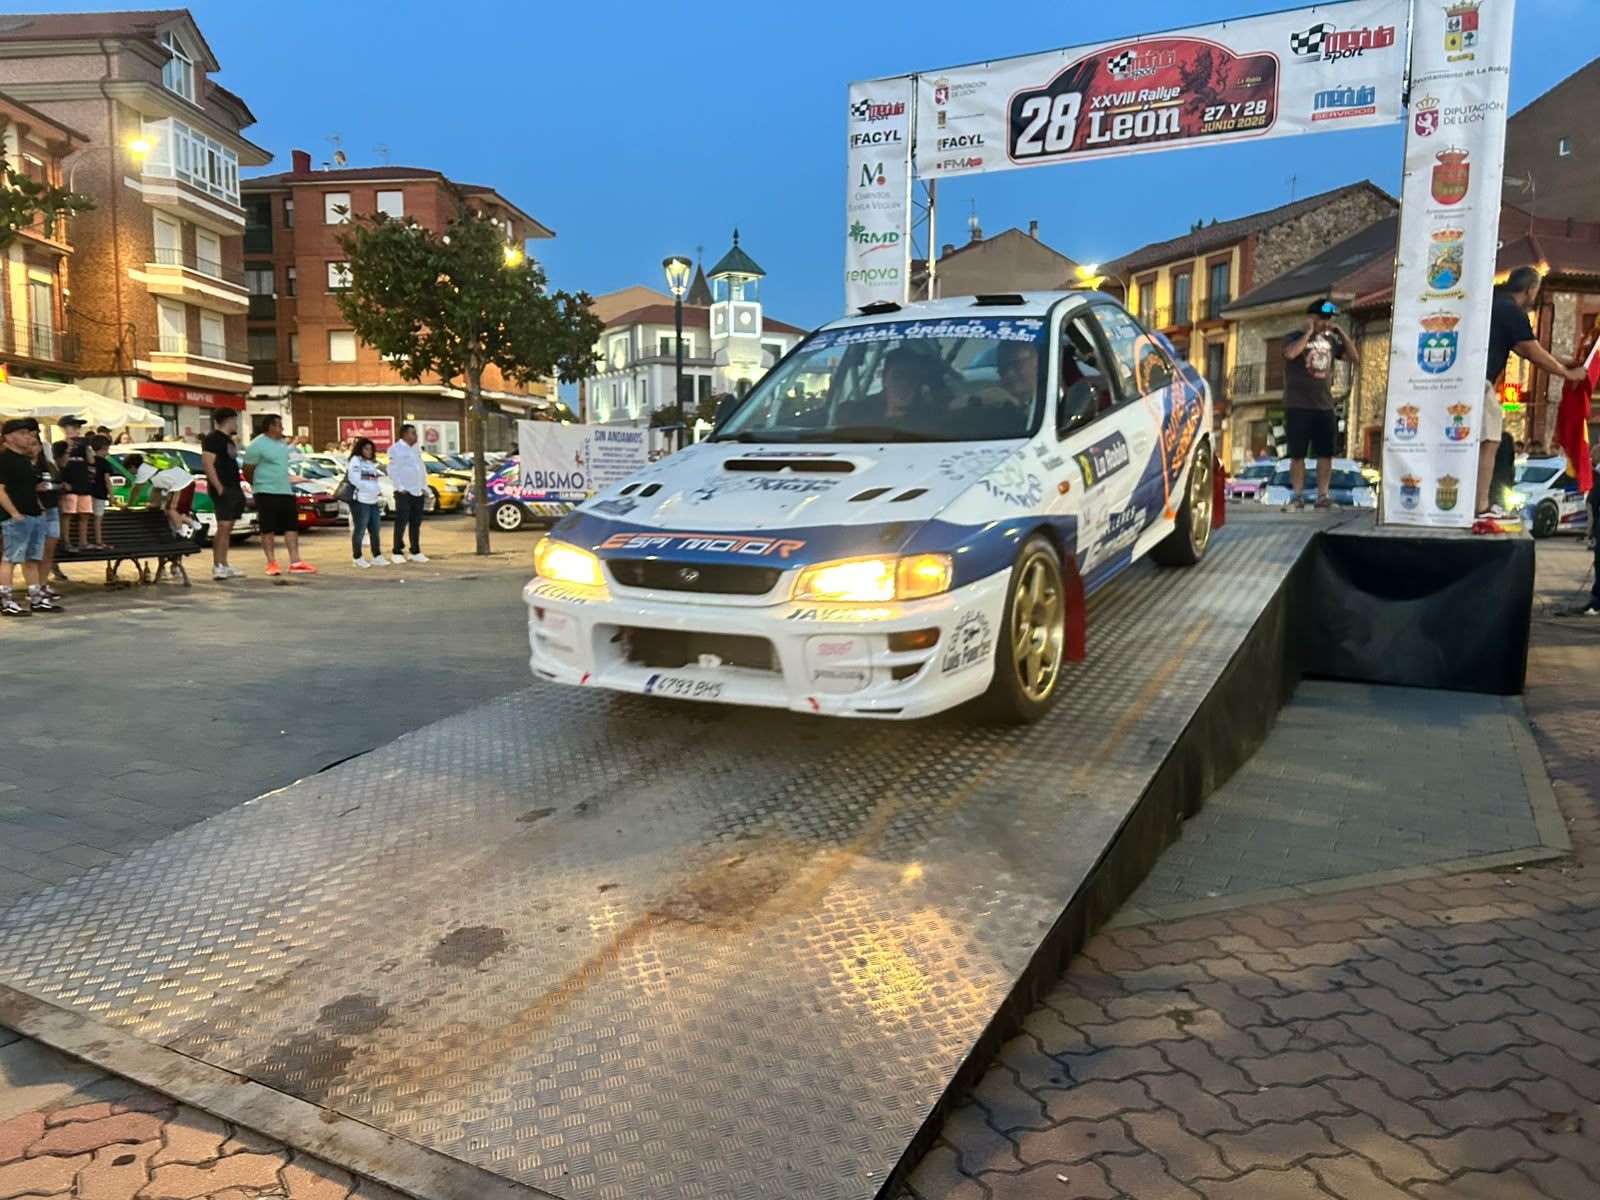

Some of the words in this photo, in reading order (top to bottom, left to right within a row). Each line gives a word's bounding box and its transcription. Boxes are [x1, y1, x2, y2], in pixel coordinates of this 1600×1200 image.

[1323, 47, 1364, 65] sport
[1090, 91, 1135, 109] XXVIII
[1138, 85, 1181, 102] Rallye
[1203, 105, 1227, 122] 27
[1230, 103, 1241, 119] Y
[1243, 100, 1268, 116] 28
[1314, 107, 1374, 120] SERVICIOS
[1443, 101, 1504, 116] DIPUTACIÓN
[1014, 91, 1083, 156] 28
[1086, 103, 1181, 144] León
[1201, 120, 1236, 133] JUNIO
[1443, 117, 1456, 125] DE
[1458, 114, 1486, 125] LEÓN
[855, 129, 902, 146] FACYL
[942, 133, 985, 149] FACYL
[859, 231, 900, 245] RMD
[846, 267, 899, 285] renova
[594, 430, 606, 441] SIN
[524, 470, 584, 489] ABISMO
[600, 533, 672, 550] ESPI
[673, 536, 807, 558] MOTOR
